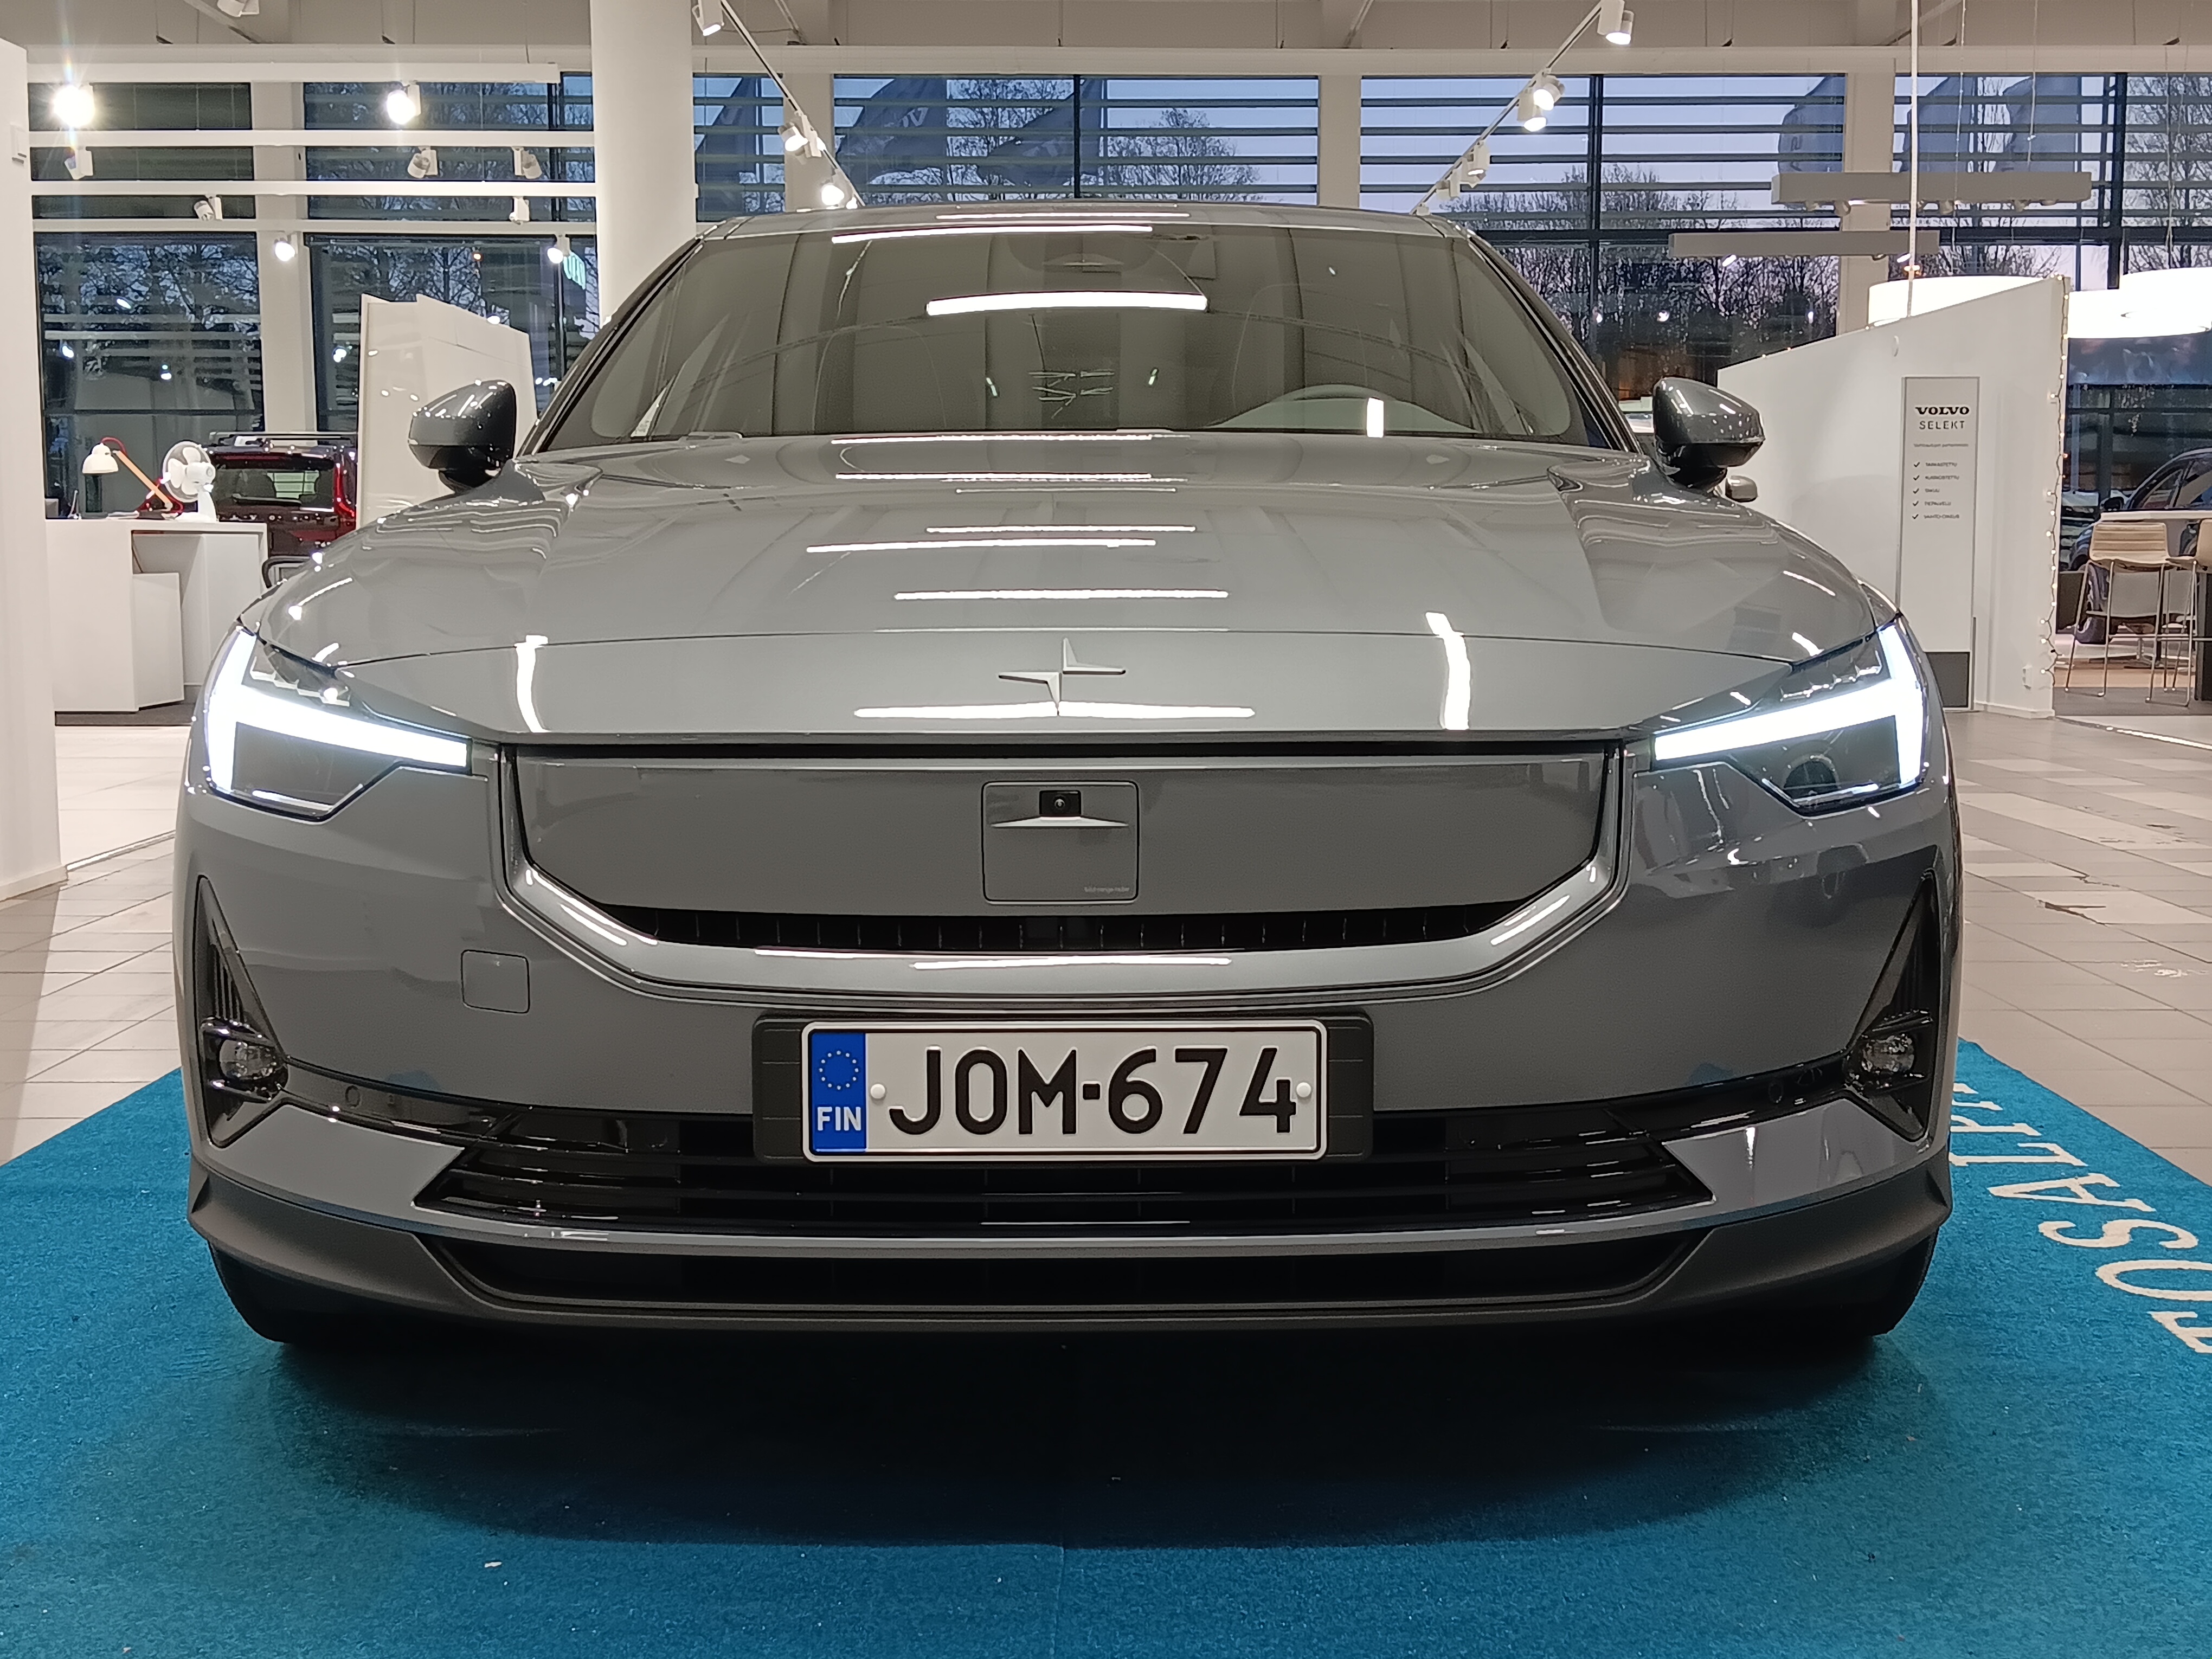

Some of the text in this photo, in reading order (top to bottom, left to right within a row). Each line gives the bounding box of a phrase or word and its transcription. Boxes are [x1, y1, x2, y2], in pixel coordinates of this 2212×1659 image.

[1915, 406, 1970, 415] VOLVO
[1919, 420, 1965, 430] SELEKT
[889, 1047, 1296, 1135] JOM-674
[817, 1107, 861, 1131] FIN
